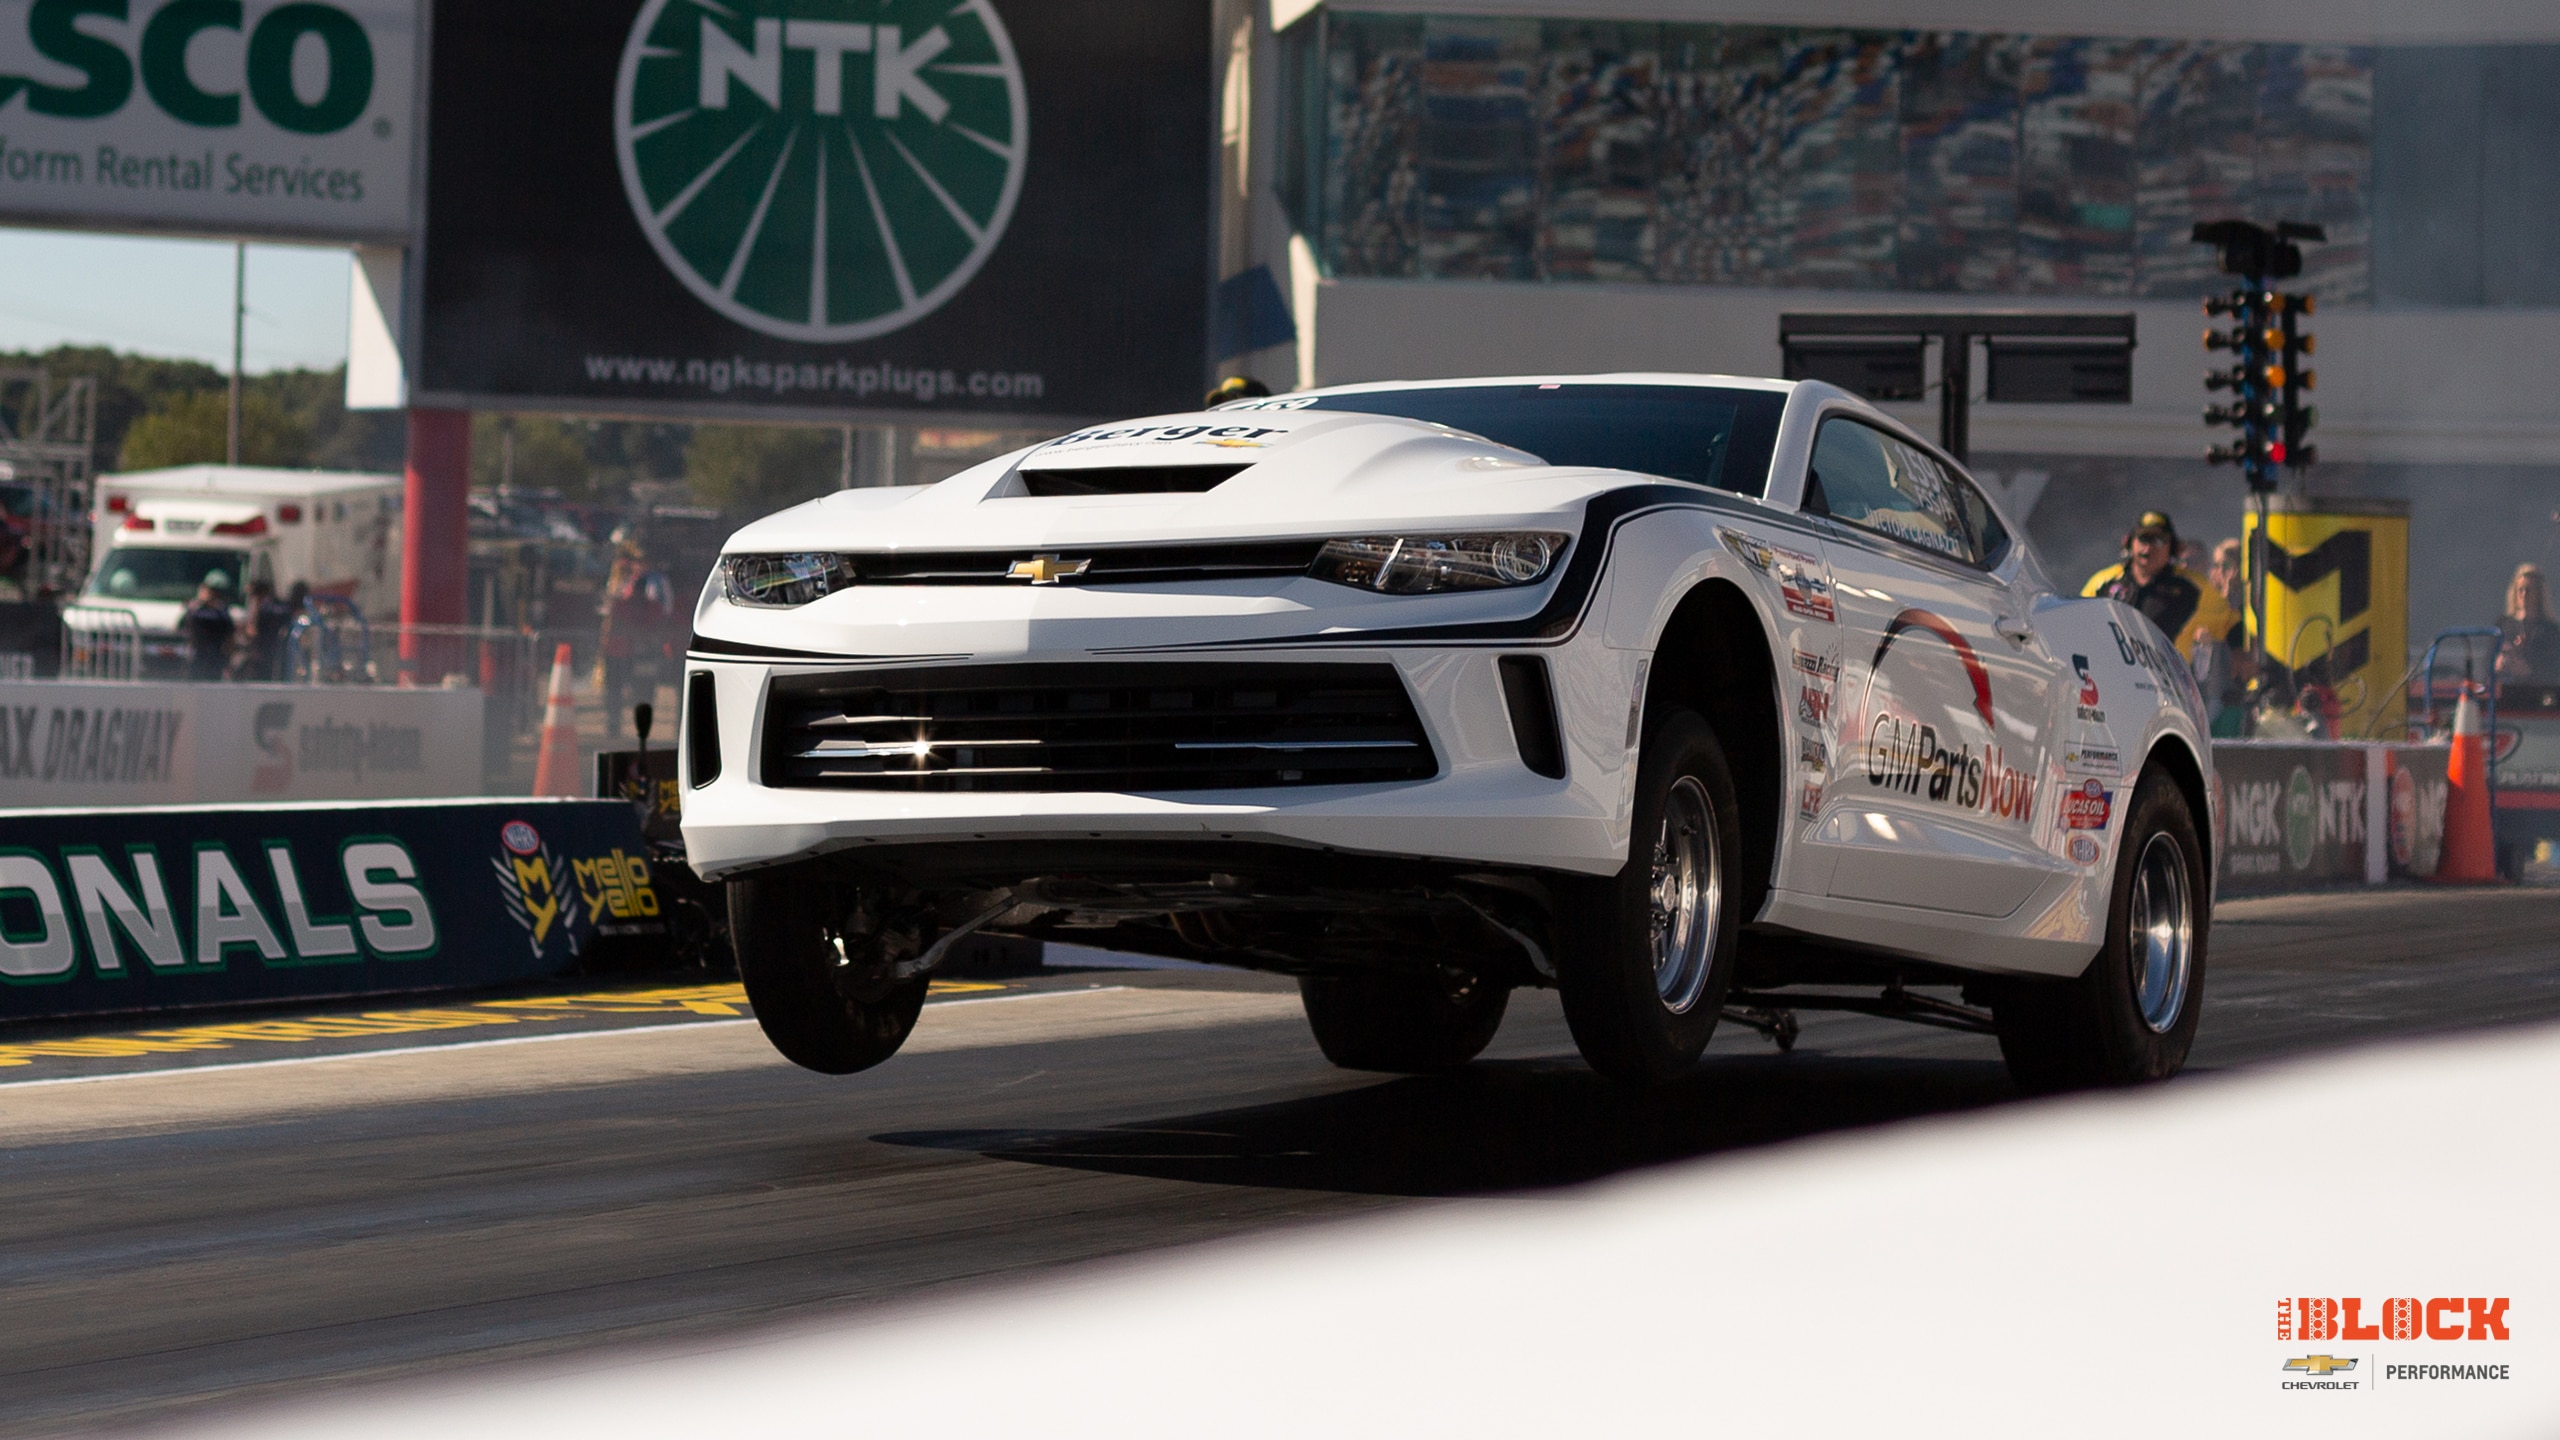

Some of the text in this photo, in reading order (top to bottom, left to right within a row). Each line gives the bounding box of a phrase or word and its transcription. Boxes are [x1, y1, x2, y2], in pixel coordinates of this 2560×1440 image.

[698, 16, 951, 124] NTK
[97, 146, 213, 190] Rental
[226, 153, 365, 201] Services
[586, 354, 1044, 402] www.ngksparkplugs.com
[1051, 424, 1288, 447] Berger
[42, 706, 184, 782] DRAGWAY
[1868, 713, 2036, 824] GMPartsNow
[2063, 799, 2105, 816] LUCAS OIL
[2229, 780, 2281, 846] NGK
[2317, 780, 2365, 844] NTK
